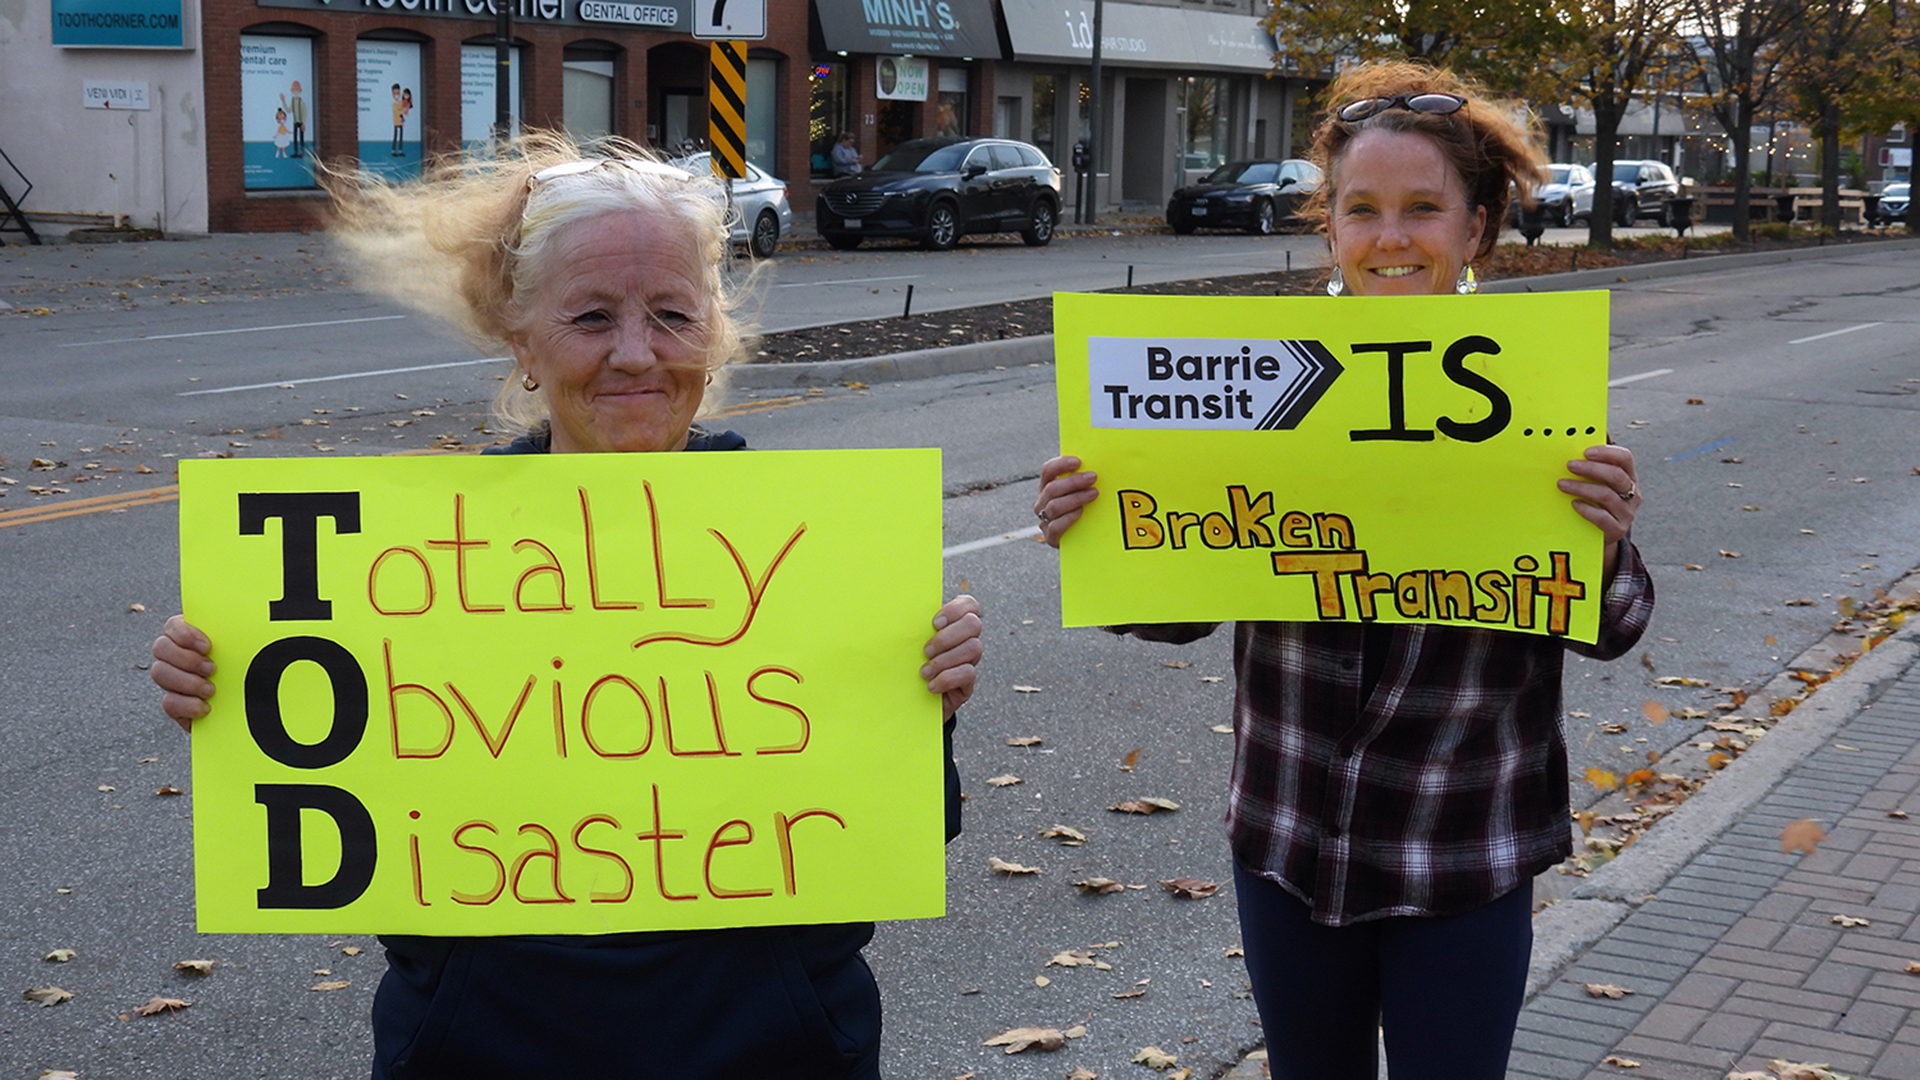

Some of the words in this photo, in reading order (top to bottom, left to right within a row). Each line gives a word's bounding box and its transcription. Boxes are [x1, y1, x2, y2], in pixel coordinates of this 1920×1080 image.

[57, 12, 178, 29] TOOTHCORNER.COM
[584, 3, 630, 21] DENTAL
[633, 8, 675, 24] OFFICE
[861, 0, 955, 30] MINH'S
[242, 44, 276, 54] remium
[242, 55, 266, 65] ental
[268, 57, 287, 66] care
[900, 66, 924, 79] NOW
[897, 82, 925, 95] OPEN
[864, 114, 875, 125] 73
[1147, 346, 1281, 381] Barrie
[1104, 385, 1253, 419] Transit
[1271, 550, 1586, 636] Transit
[244, 635, 811, 770] Obvious
[254, 783, 847, 910] Disaster
